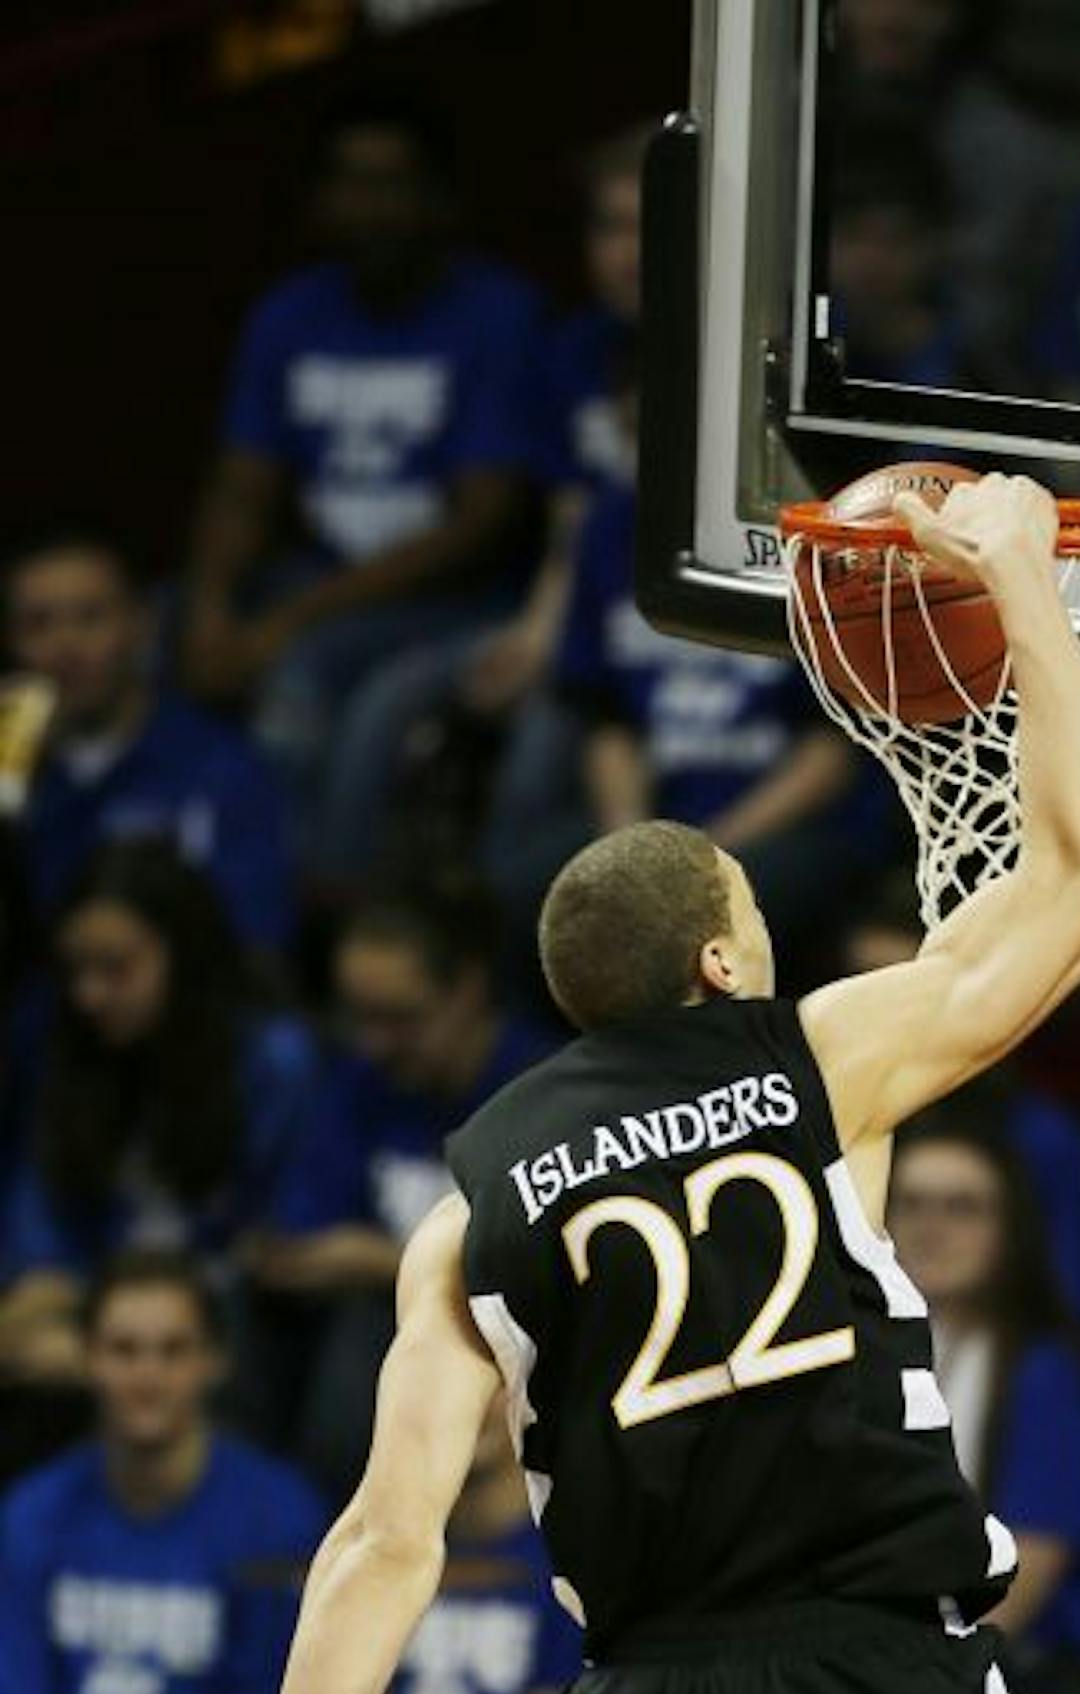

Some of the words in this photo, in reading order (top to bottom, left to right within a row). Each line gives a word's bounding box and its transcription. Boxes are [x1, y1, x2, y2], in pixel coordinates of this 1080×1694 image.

[744, 529, 782, 567] SPA
[507, 1072, 799, 1225] ISLANDERS
[561, 1152, 856, 1431] 22
